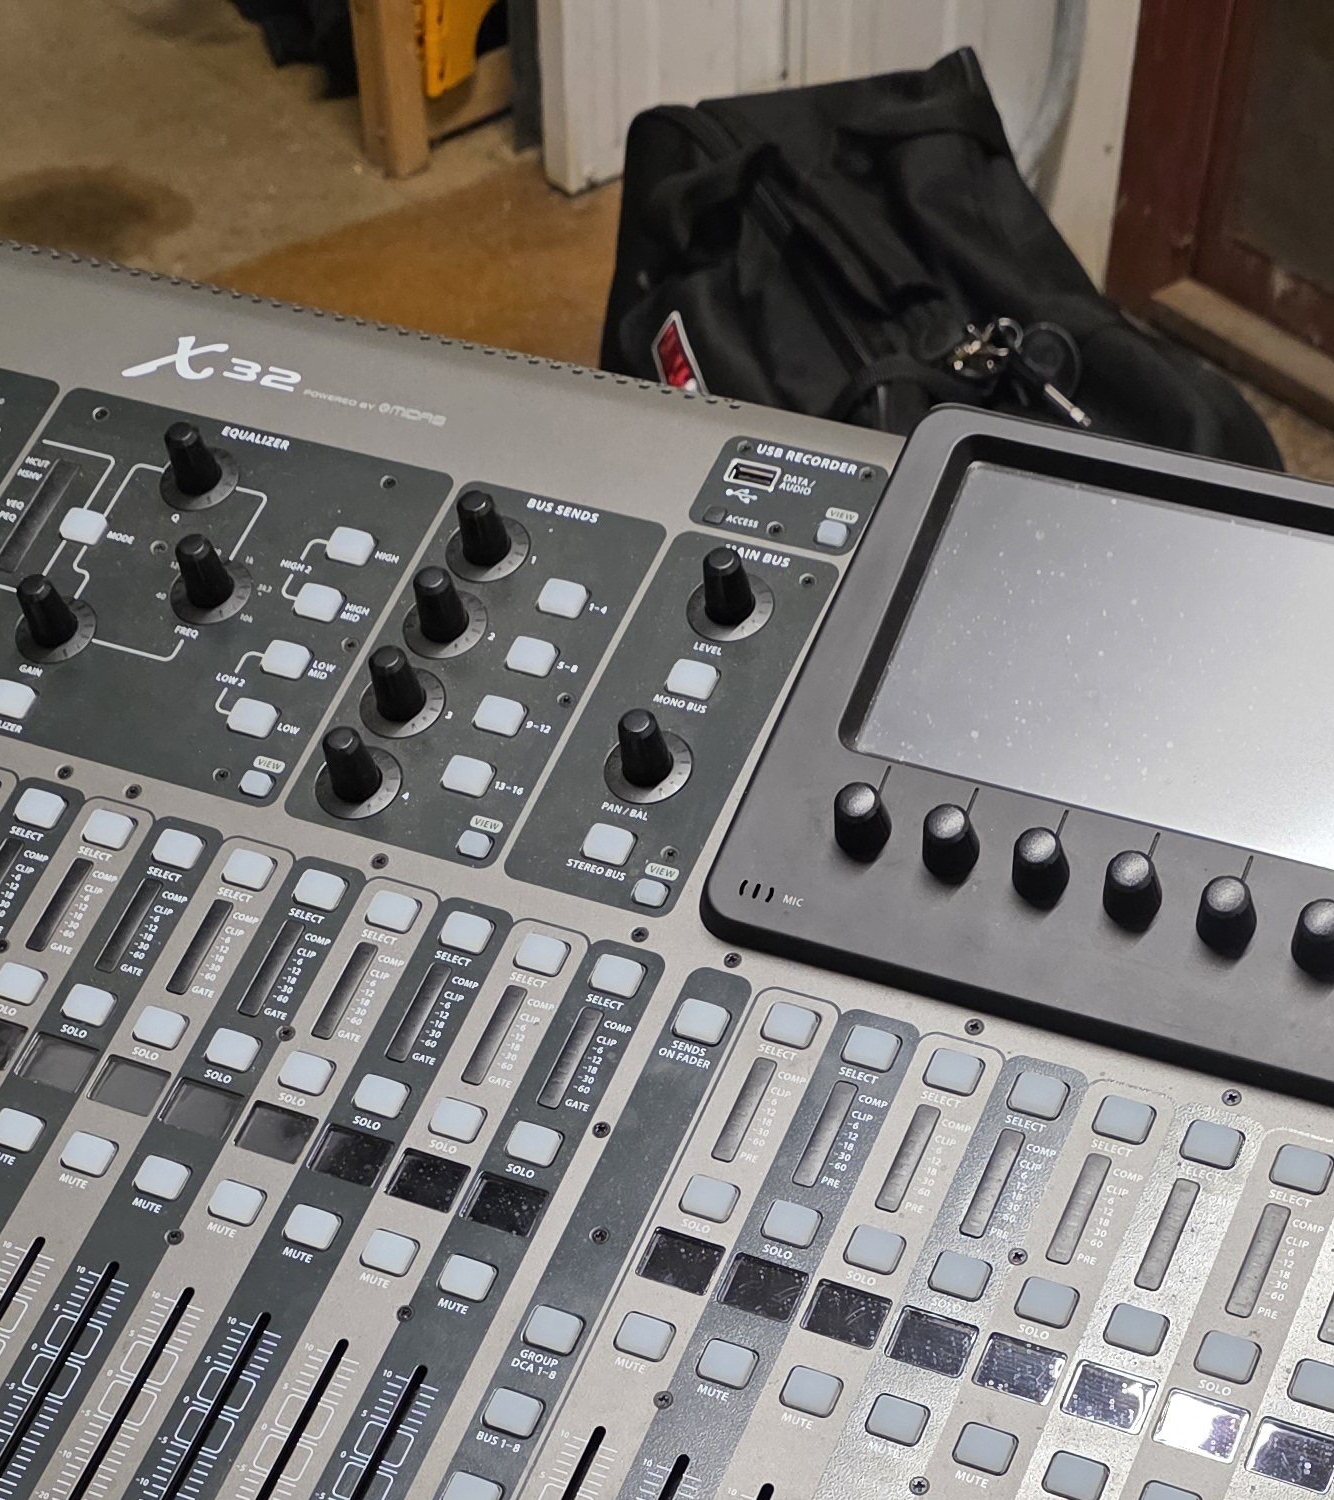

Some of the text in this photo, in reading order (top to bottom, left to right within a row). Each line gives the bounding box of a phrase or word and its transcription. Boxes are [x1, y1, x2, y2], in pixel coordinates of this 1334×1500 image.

[122, 335, 302, 392] X32
[303, 388, 358, 407] POWERED
[359, 401, 376, 411] BY
[222, 425, 290, 451] EQUALIZER
[756, 442, 858, 476] USB RECORDER
[782, 473, 809, 487] DATA
[779, 482, 812, 496] AUDIO
[6, 498, 25, 511] VEQ
[526, 497, 600, 524] BUS SENDS
[725, 514, 759, 529] ACCESS
[106, 530, 135, 545] MODE
[375, 550, 400, 564] HIGH
[725, 544, 791, 568] AIN BUS
[345, 602, 371, 616] HIGH
[589, 602, 608, 615] 1-4
[340, 611, 361, 624] MID
[174, 624, 199, 640] FREQ
[693, 641, 722, 656] LEVEL
[18, 664, 44, 677] GAIN
[308, 668, 328, 680] MID
[313, 659, 337, 674] LOW
[216, 672, 246, 687] LOW 2
[653, 693, 708, 714] MONO BUS
[277, 722, 301, 736] LOW
[525, 720, 552, 735] 9-12
[494, 781, 524, 796] 13-16
[601, 801, 623, 815] PAN
[629, 807, 648, 821] BAL
[474, 818, 501, 831] VIEW
[566, 858, 627, 882] STEREO BUS
[650, 866, 676, 879] VIEW
[782, 894, 804, 907] MIC
[585, 993, 625, 1011] SELECT
[603, 1020, 632, 1034] COMP
[596, 1034, 618, 1047] CLIP
[671, 1039, 707, 1057] SENDS
[658, 1047, 711, 1070] ON FADER
[564, 1098, 590, 1112] GATE
[519, 1349, 559, 1368] GROUP
[510, 1357, 557, 1380] DCA 1-8
[475, 1430, 521, 1453] BUS 1-8
